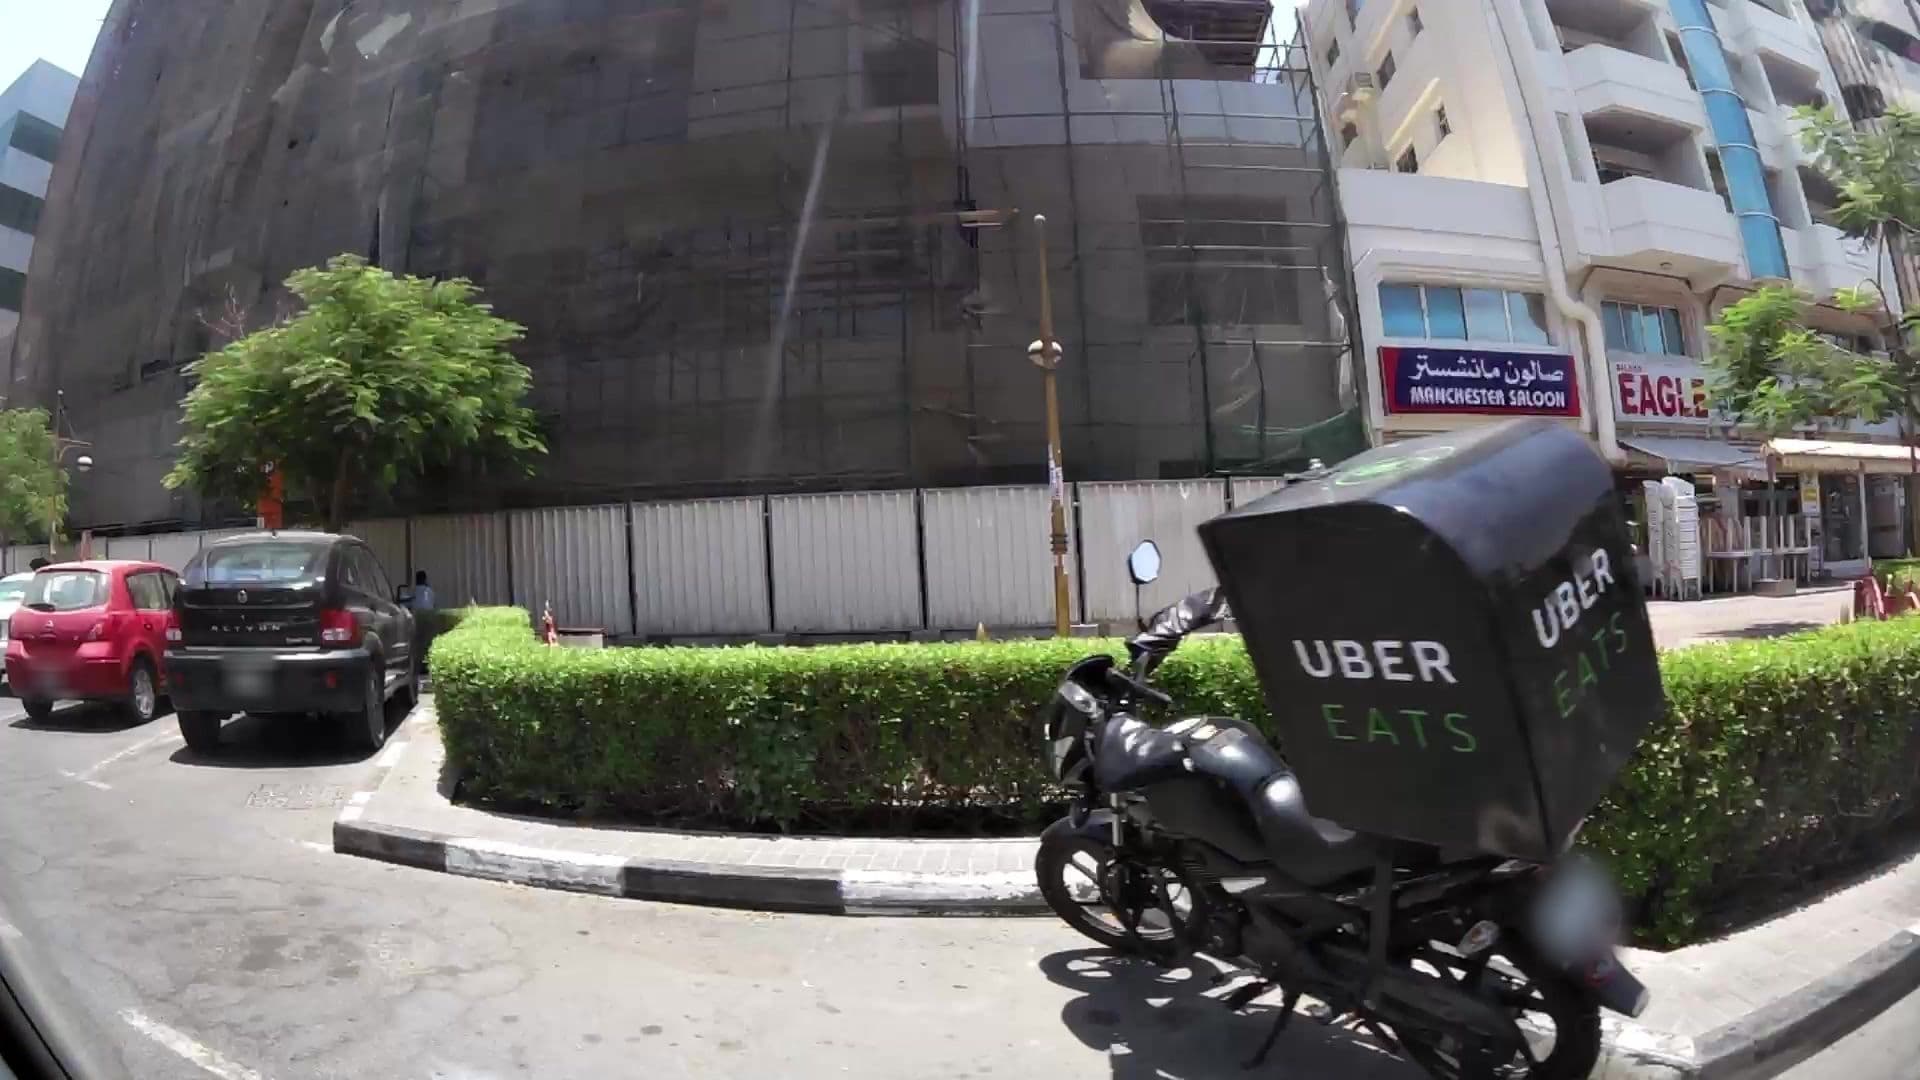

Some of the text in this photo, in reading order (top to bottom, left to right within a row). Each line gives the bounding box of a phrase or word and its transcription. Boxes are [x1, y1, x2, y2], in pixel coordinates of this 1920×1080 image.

[1408, 354, 1564, 387] صالون مانشستر
[1409, 386, 1565, 407] MANCHESTER SALOON
[1618, 373, 1709, 418] EAGLE
[1532, 547, 1616, 650] UBER
[1292, 638, 1459, 684] UBER
[1553, 611, 1627, 719] EATS
[1322, 703, 1479, 753] EATS
